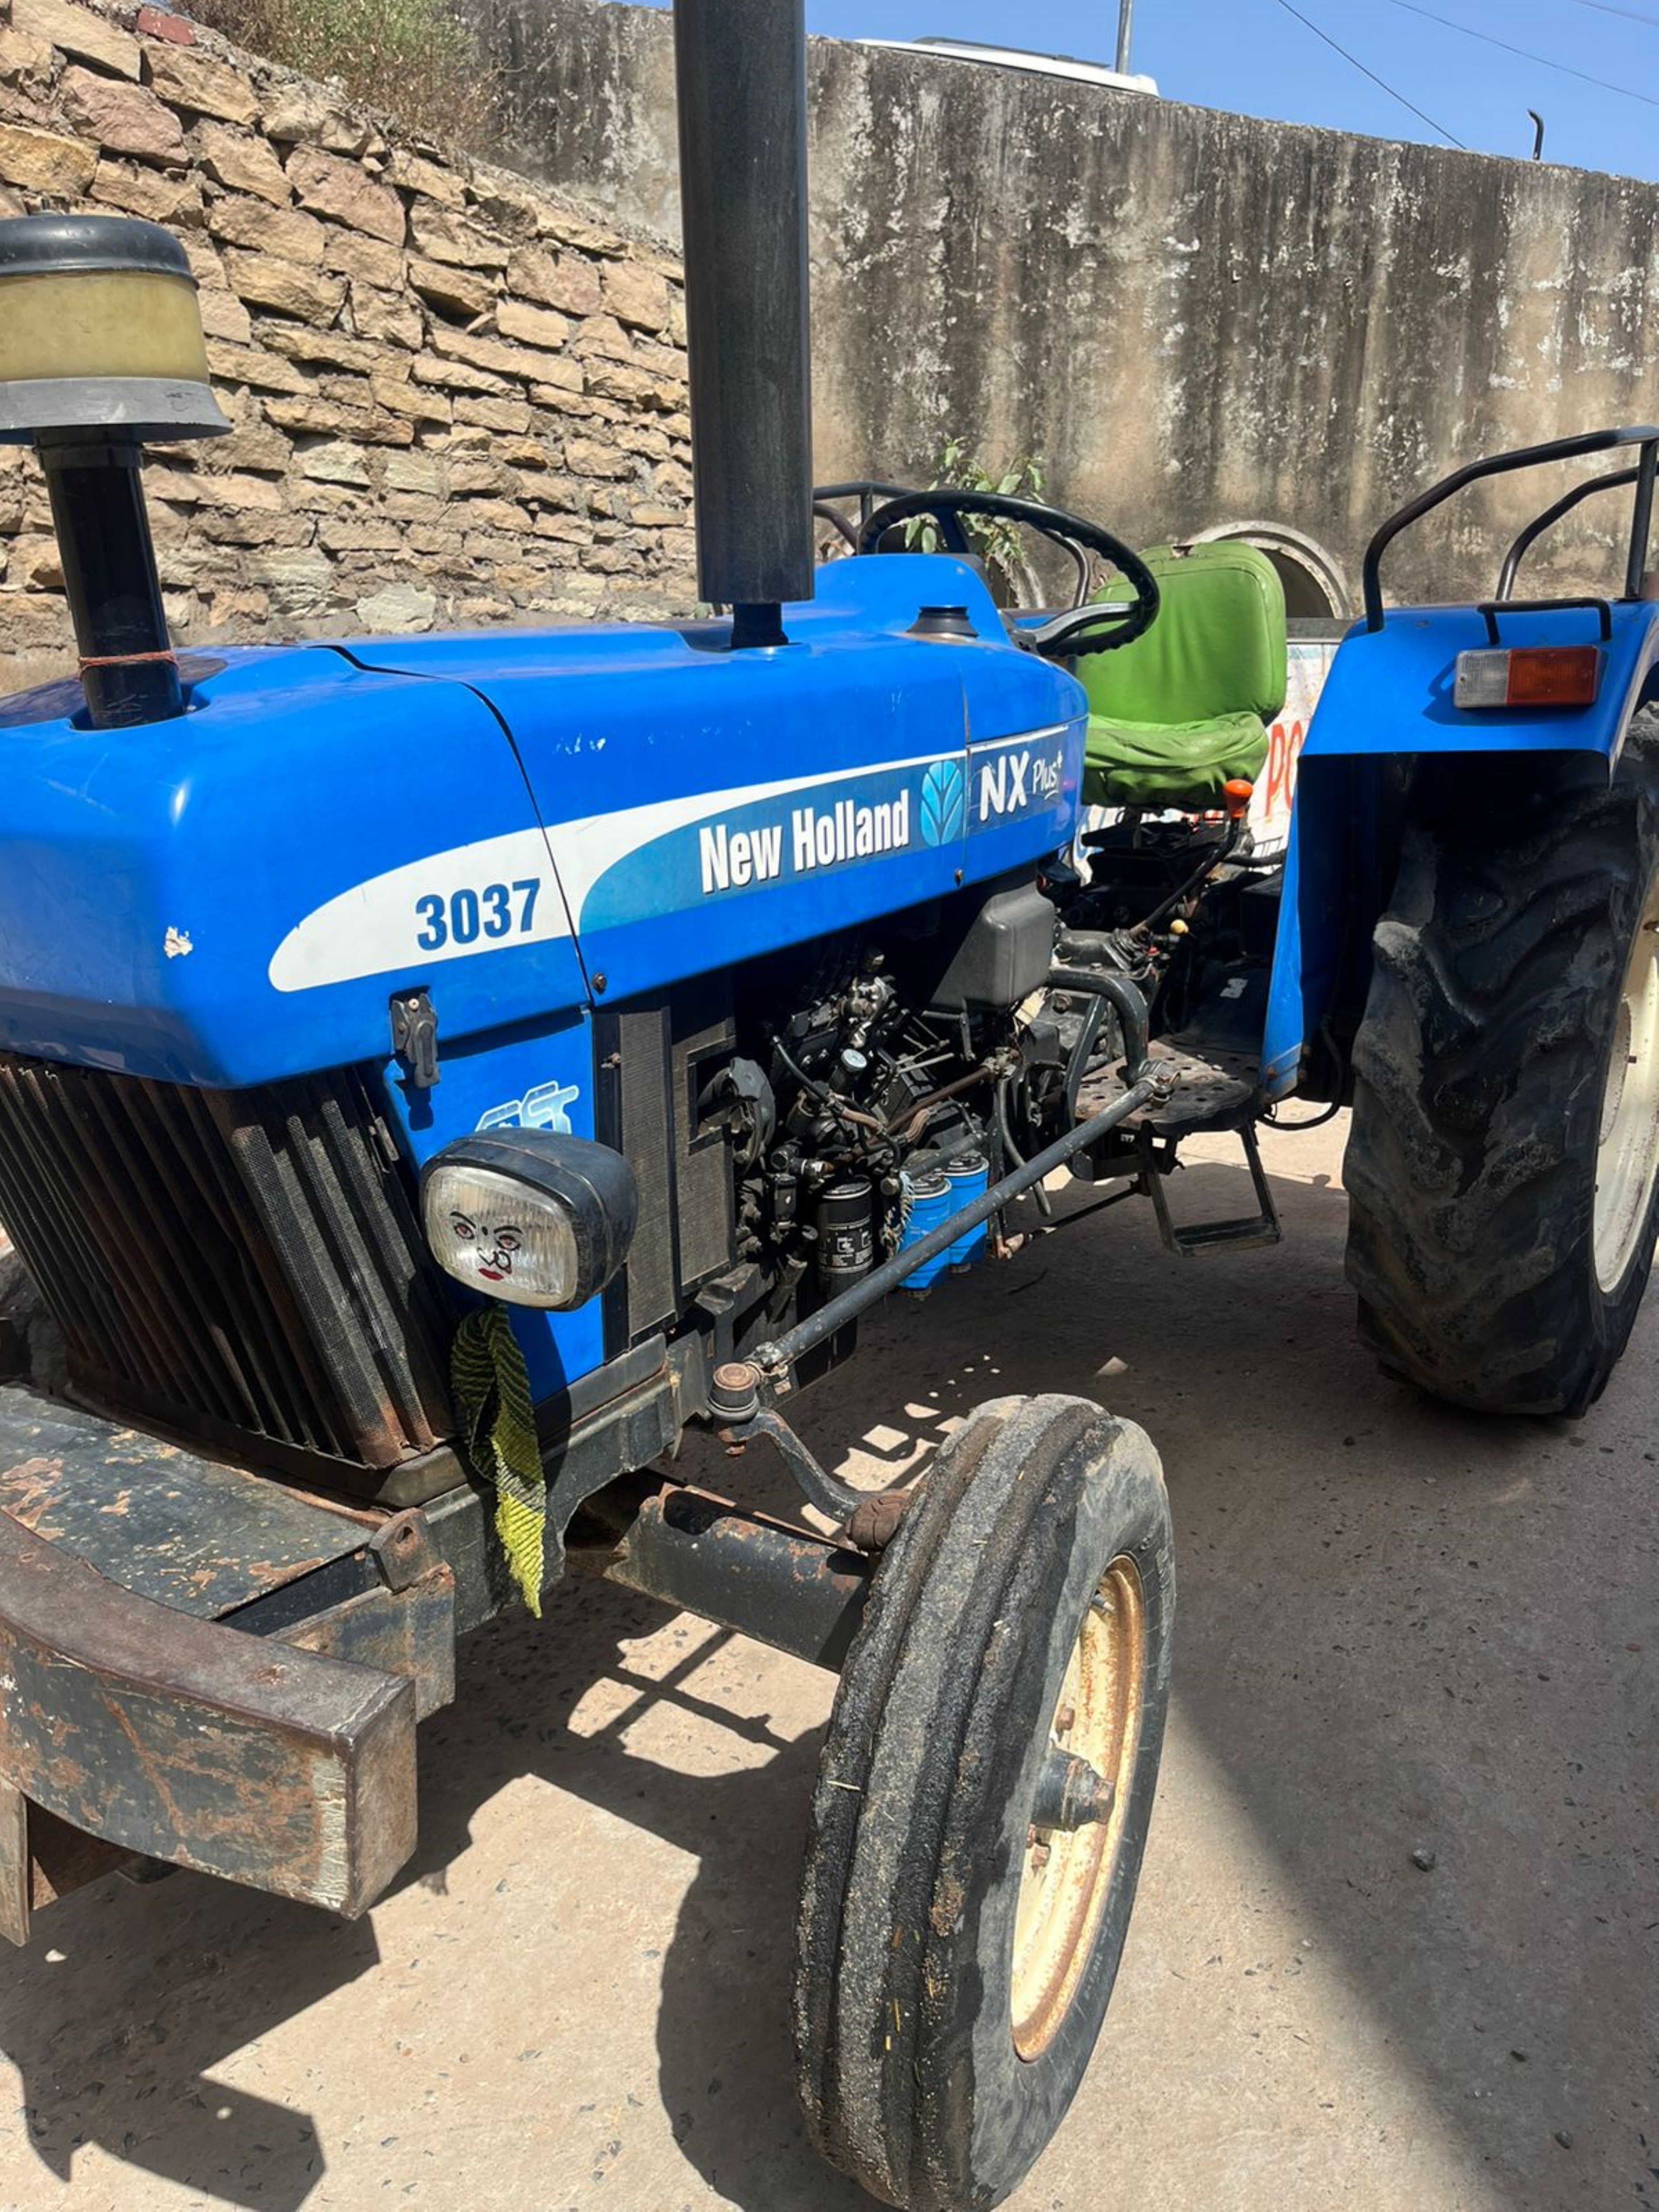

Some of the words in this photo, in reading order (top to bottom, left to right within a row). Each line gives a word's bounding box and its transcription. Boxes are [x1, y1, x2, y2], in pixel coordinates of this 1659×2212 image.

[979, 750, 1030, 822] NX
[699, 824, 783, 894] New
[792, 788, 910, 872] Holland
[415, 877, 541, 951] 3037
